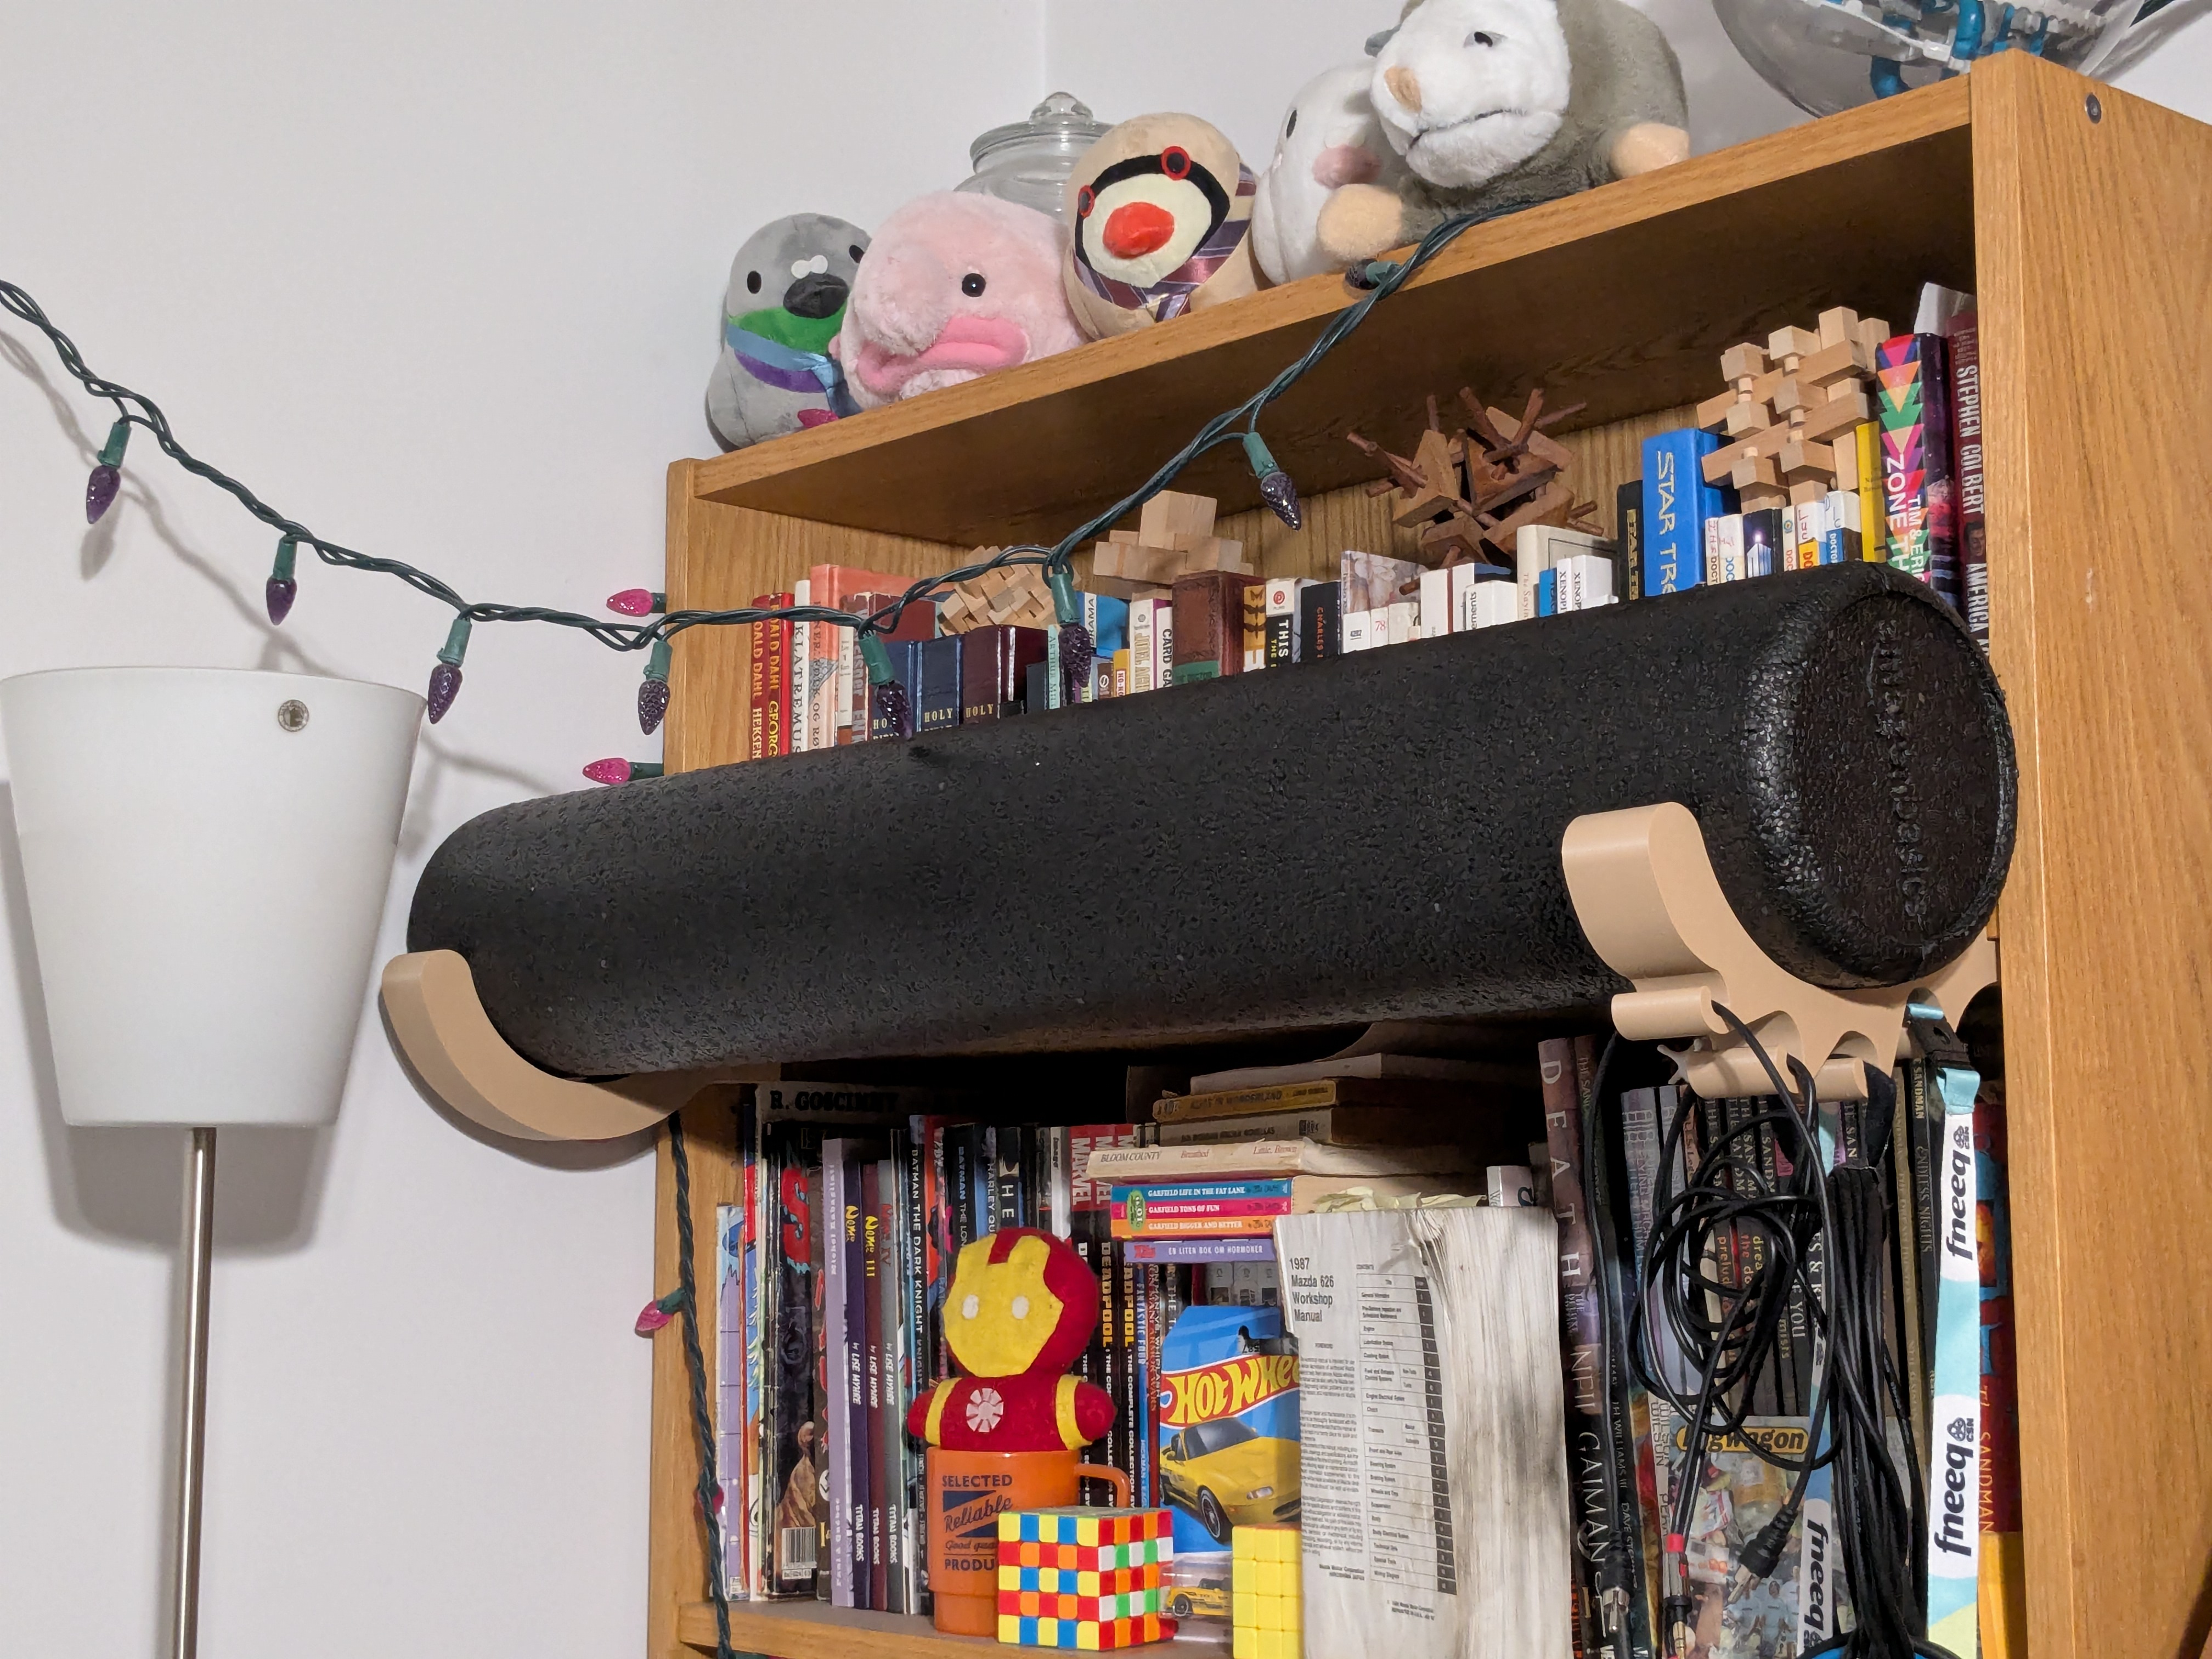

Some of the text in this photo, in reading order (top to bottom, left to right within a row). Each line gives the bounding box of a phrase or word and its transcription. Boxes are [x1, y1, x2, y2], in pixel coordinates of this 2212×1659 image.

[1956, 365, 1978, 438] STEPHEN
[1657, 450, 1675, 535] STAR
[1887, 454, 1908, 530] ZONE
[1959, 444, 1984, 514] COLBERT
[1803, 551, 1814, 569] DO
[1908, 494, 1925, 583] TIM & ERIC
[1966, 563, 1989, 633] AMERICA
[1048, 635, 1057, 679] ARTHUR
[1162, 628, 1172, 664] CARD
[1278, 619, 1289, 658] THIS
[769, 656, 780, 690] DAHL
[792, 625, 804, 753] KLATREMUS
[752, 663, 763, 759] DAHL HEKSEN
[768, 701, 779, 758] GEORG
[812, 703, 820, 722] OG
[924, 708, 953, 723] HOLY
[966, 703, 994, 718] HOLY
[1913, 1066, 1926, 1119] SANDMAN
[911, 1149, 920, 1199] BATMAN
[1071, 1137, 1092, 1205] MARVEL
[1101, 1151, 1162, 1163] BLOOM COUNTY
[1541, 1059, 1581, 1277] DEATH
[987, 1162, 996, 1213] HARLEY
[1148, 1189, 1178, 1198] GARFIELD
[1201, 1187, 1215, 1195] THE
[1215, 1187, 1227, 1195] FAT
[1228, 1186, 1246, 1194] LANE
[1148, 1205, 1179, 1214] GARFIELD
[1915, 1145, 1934, 1252] ENDLESS NIGHTS
[1946, 1149, 1974, 1262] fneeq
[913, 1203, 922, 1232] THE
[1148, 1222, 1179, 1231] GARFIELD
[866, 1260, 876, 1278] III
[913, 1235, 922, 1274] DARK
[1199, 1246, 1212, 1255] BOK
[1214, 1246, 1225, 1255] OM
[1289, 1257, 1310, 1271] 1987
[1717, 1235, 1734, 1286] prelud
[1740, 1234, 1751, 1259] the
[1752, 1235, 1764, 1272] drea
[1101, 1242, 1113, 1348] DEADPOOL
[1167, 1285, 1177, 1311] THE
[1291, 1274, 1335, 1288] Mazda 626
[1292, 1291, 1334, 1309] Workshop
[915, 1279, 924, 1333] KNIGHT
[1136, 1283, 1146, 1335] FANTASTIC
[1294, 1308, 1323, 1323] Manual
[1790, 1301, 1806, 1338] YOU
[1137, 1339, 1146, 1365] FOUR
[1124, 1262, 1135, 1347] ADPOOL
[1130, 1494, 1135, 1508] BY
[1166, 1370, 1229, 1425] Hot
[1570, 1351, 1610, 1563] NEIL GAIMAN
[1613, 1417, 1627, 1477] WILLIAMS
[941, 1474, 1013, 1488] SELECTED
[1934, 1442, 1974, 1558] fneeq
[1979, 1431, 1997, 1534] SANDMAN
[855, 1504, 865, 1562] TITAN BOOKS
[872, 1507, 881, 1565] TITAN BOOKS
[889, 1504, 898, 1564] TITAN BOOKS
[943, 1495, 1014, 1534] Reliable
[1621, 1502, 1633, 1533] DAVE
[944, 1558, 995, 1571] PRODU
[945, 1539, 971, 1550] Good
[1807, 1522, 1829, 1633] fneeq
